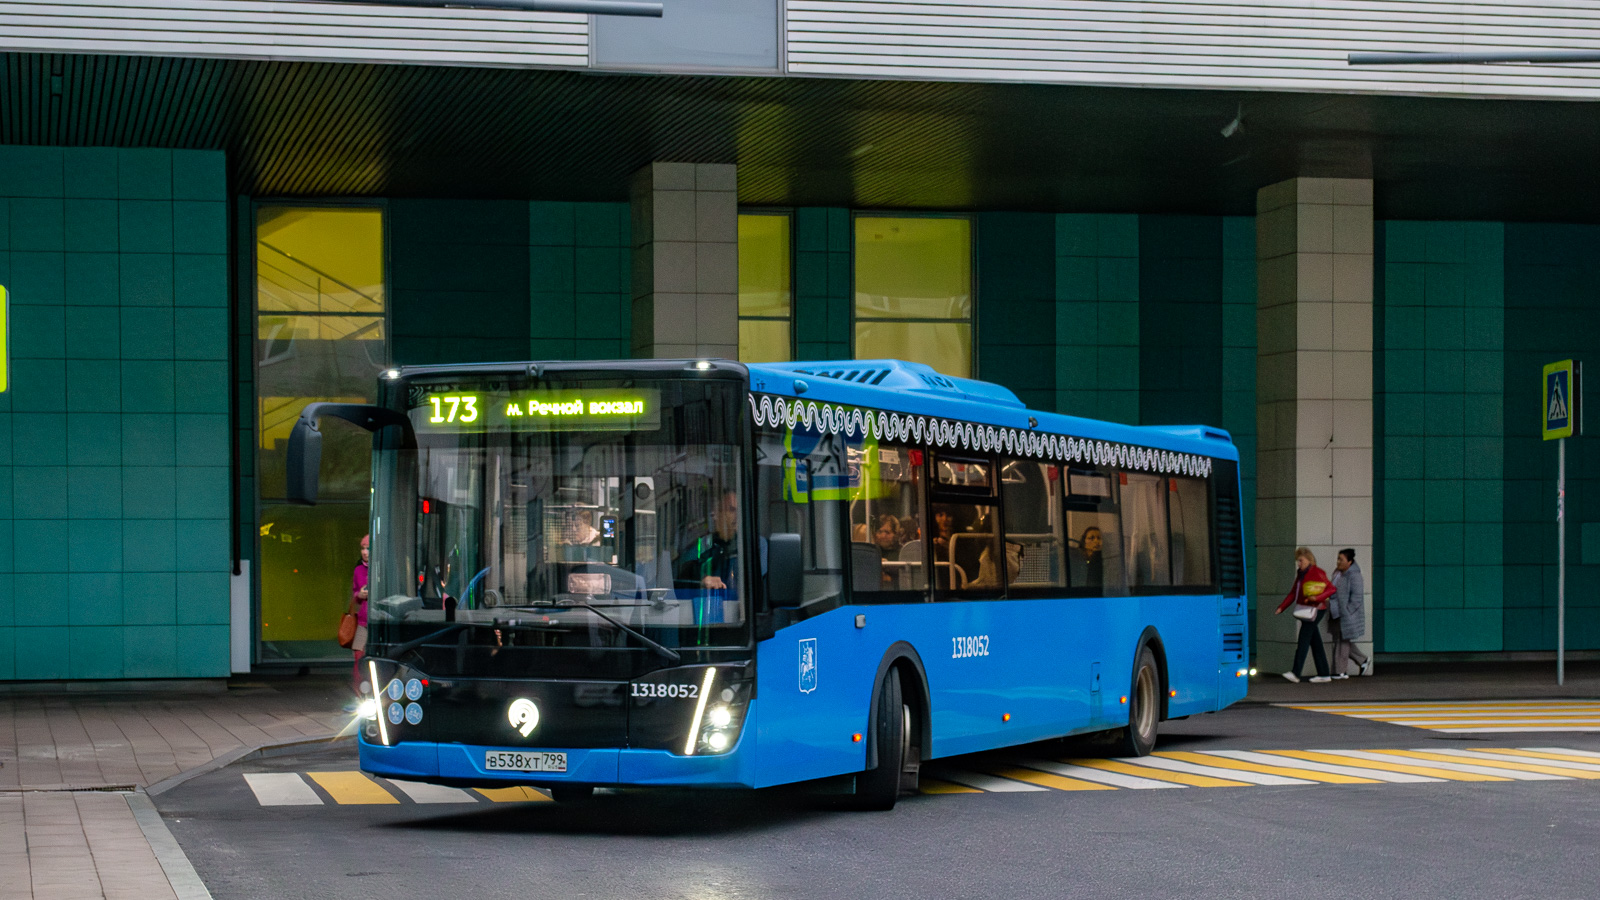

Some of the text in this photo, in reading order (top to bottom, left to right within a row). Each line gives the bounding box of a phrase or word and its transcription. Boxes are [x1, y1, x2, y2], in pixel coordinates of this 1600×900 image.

[429, 396, 478, 423] 173
[528, 399, 583, 416] Речной
[589, 400, 643, 415] вокзал
[951, 636, 990, 659] 1318052
[631, 683, 699, 699] 1318052
[489, 753, 564, 769] В538ХТ 799
